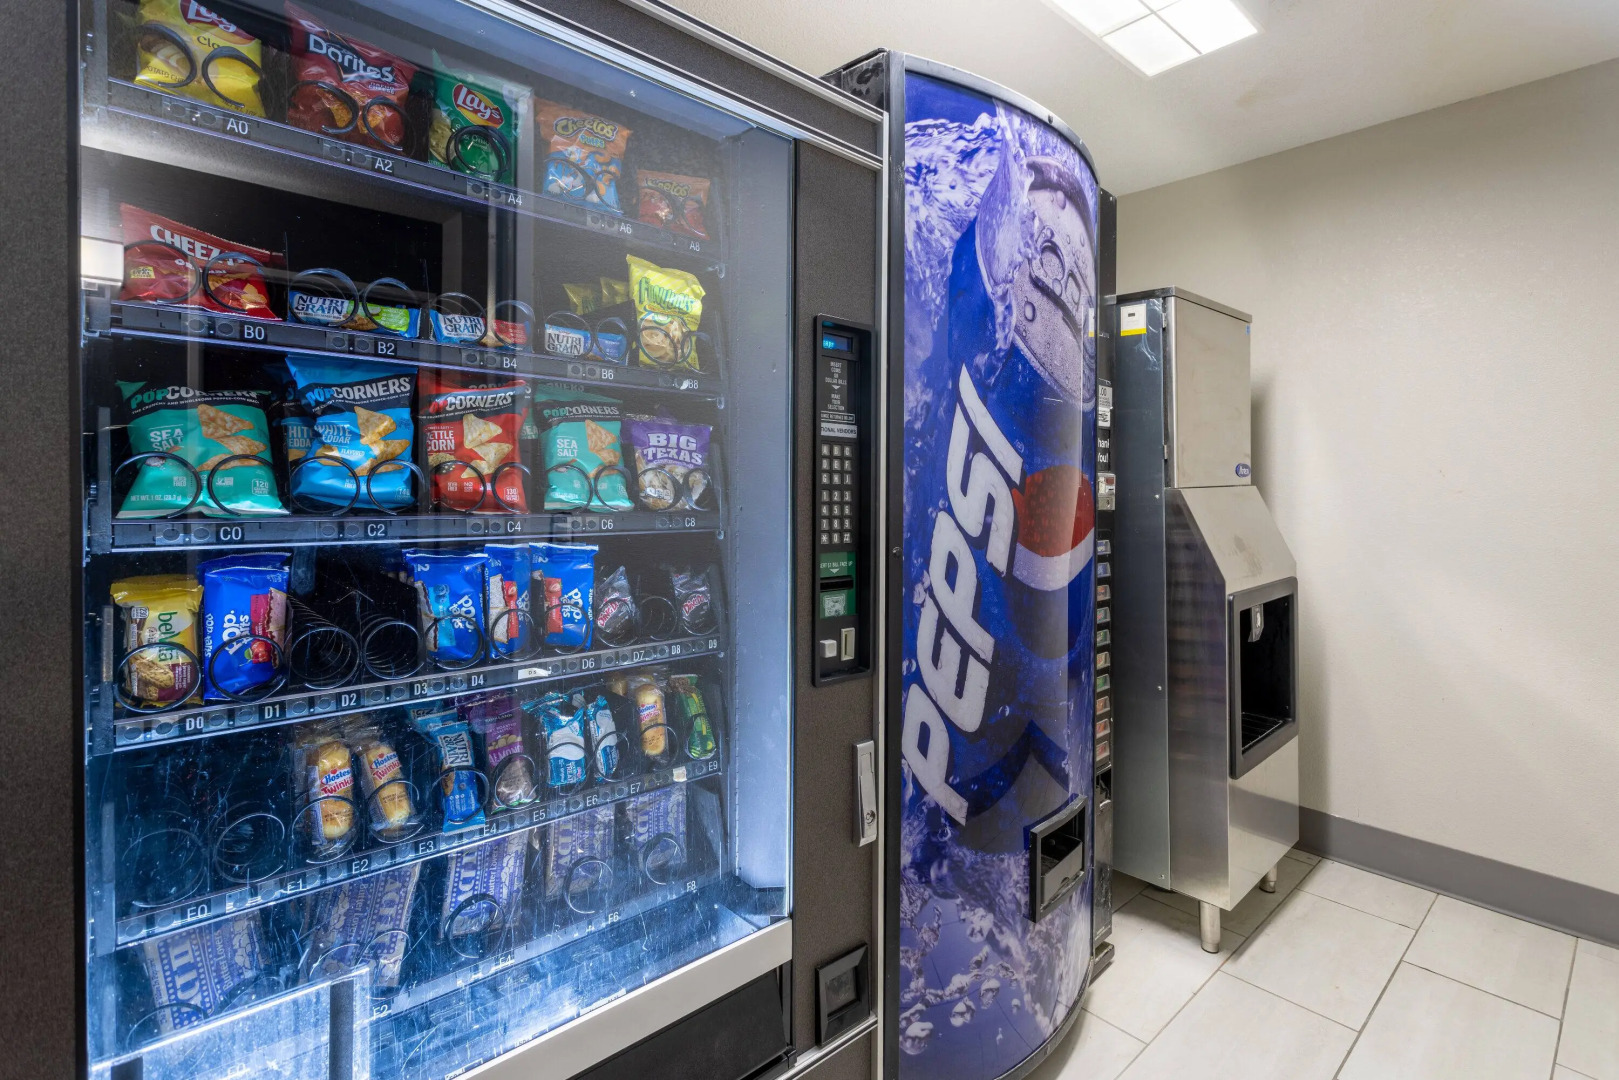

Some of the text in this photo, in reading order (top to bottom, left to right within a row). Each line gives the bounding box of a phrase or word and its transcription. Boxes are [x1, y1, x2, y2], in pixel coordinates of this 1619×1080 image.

[309, 34, 394, 82] Doritos
[457, 86, 500, 120] Lay's
[227, 118, 249, 136] A0
[556, 118, 617, 139] Cheetos
[375, 158, 394, 172] A2
[508, 192, 522, 206] A4
[620, 222, 632, 234] A6
[690, 241, 700, 252] A8
[298, 296, 346, 308] NUTRI
[294, 304, 344, 315] GRAIN
[443, 315, 482, 328] NUTRI
[244, 324, 265, 340] B0
[444, 324, 483, 334] GRAIN
[547, 332, 582, 345] NUTRI
[378, 342, 395, 355] B2
[546, 342, 582, 354] GRAIN
[504, 357, 517, 368] B4
[602, 370, 614, 380] B6
[688, 379, 699, 389] B8
[305, 377, 410, 406] POPCORNERS
[543, 405, 619, 418] POPCORNERS
[150, 428, 184, 442] SEA
[314, 424, 352, 437] WHITE
[557, 439, 578, 449] SEA
[648, 433, 696, 451] BIG
[557, 449, 578, 457] SALT
[644, 447, 702, 465] TEXAS
[507, 522, 521, 532] C4
[602, 520, 614, 530] C6
[685, 518, 696, 526] C8
[220, 526, 242, 540] C0
[367, 524, 385, 537] C2
[902, 364, 1023, 826] PEPSI
[672, 645, 680, 654] D8
[709, 640, 717, 648] D9
[633, 652, 645, 661] D7
[582, 659, 595, 669] D6
[471, 675, 484, 686] D4
[414, 683, 428, 695] D3
[342, 694, 357, 706] D2
[265, 705, 280, 718] D1
[186, 717, 204, 731] D0
[443, 736, 460, 764] GRAIN
[454, 734, 469, 763] NUTRI
[374, 752, 398, 768] Hostes
[708, 761, 718, 770] E9
[324, 768, 351, 784] Hostes
[373, 760, 402, 780] Twinki
[321, 777, 354, 795] Twinki
[630, 783, 641, 793] E7
[586, 795, 598, 806] E6
[533, 809, 546, 822] E5
[484, 825, 497, 835] E4
[419, 841, 434, 854] E3
[352, 860, 369, 874] E2
[287, 878, 302, 893] E1
[687, 880, 696, 892] F8
[187, 904, 208, 920] E0
[608, 912, 619, 924] F6
[220, 965, 234, 990] Butter
[373, 1004, 388, 1020] F2
